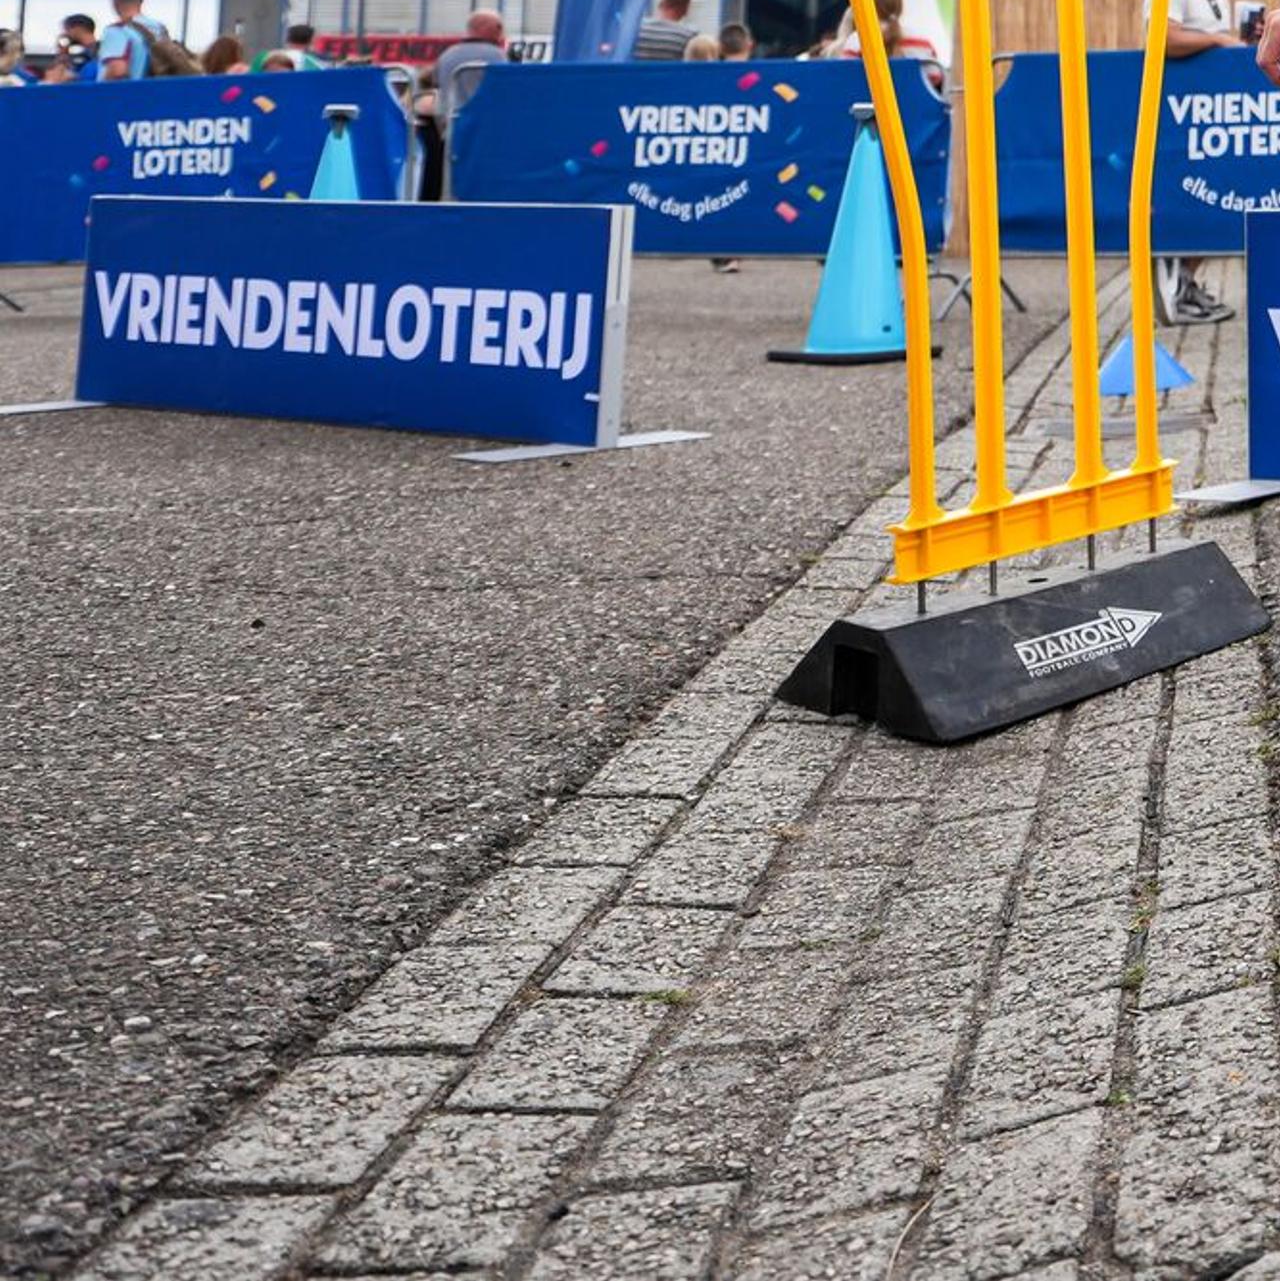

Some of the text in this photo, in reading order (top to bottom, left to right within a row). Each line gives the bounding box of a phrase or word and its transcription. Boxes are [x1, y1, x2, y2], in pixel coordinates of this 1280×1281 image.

[117, 116, 251, 147] VRIENDEN
[618, 104, 771, 133] VRIENDEN
[132, 146, 233, 179] LOTERIJ
[634, 135, 749, 168] LOTERIJ
[627, 179, 749, 222] elke dag plezier
[1182, 175, 1219, 206] elke
[95, 271, 593, 380] VRIENDENLOTERIJ
[1017, 617, 1136, 666] DIAMOND
[1028, 642, 1129, 678] FOOTBALL COMPANY
